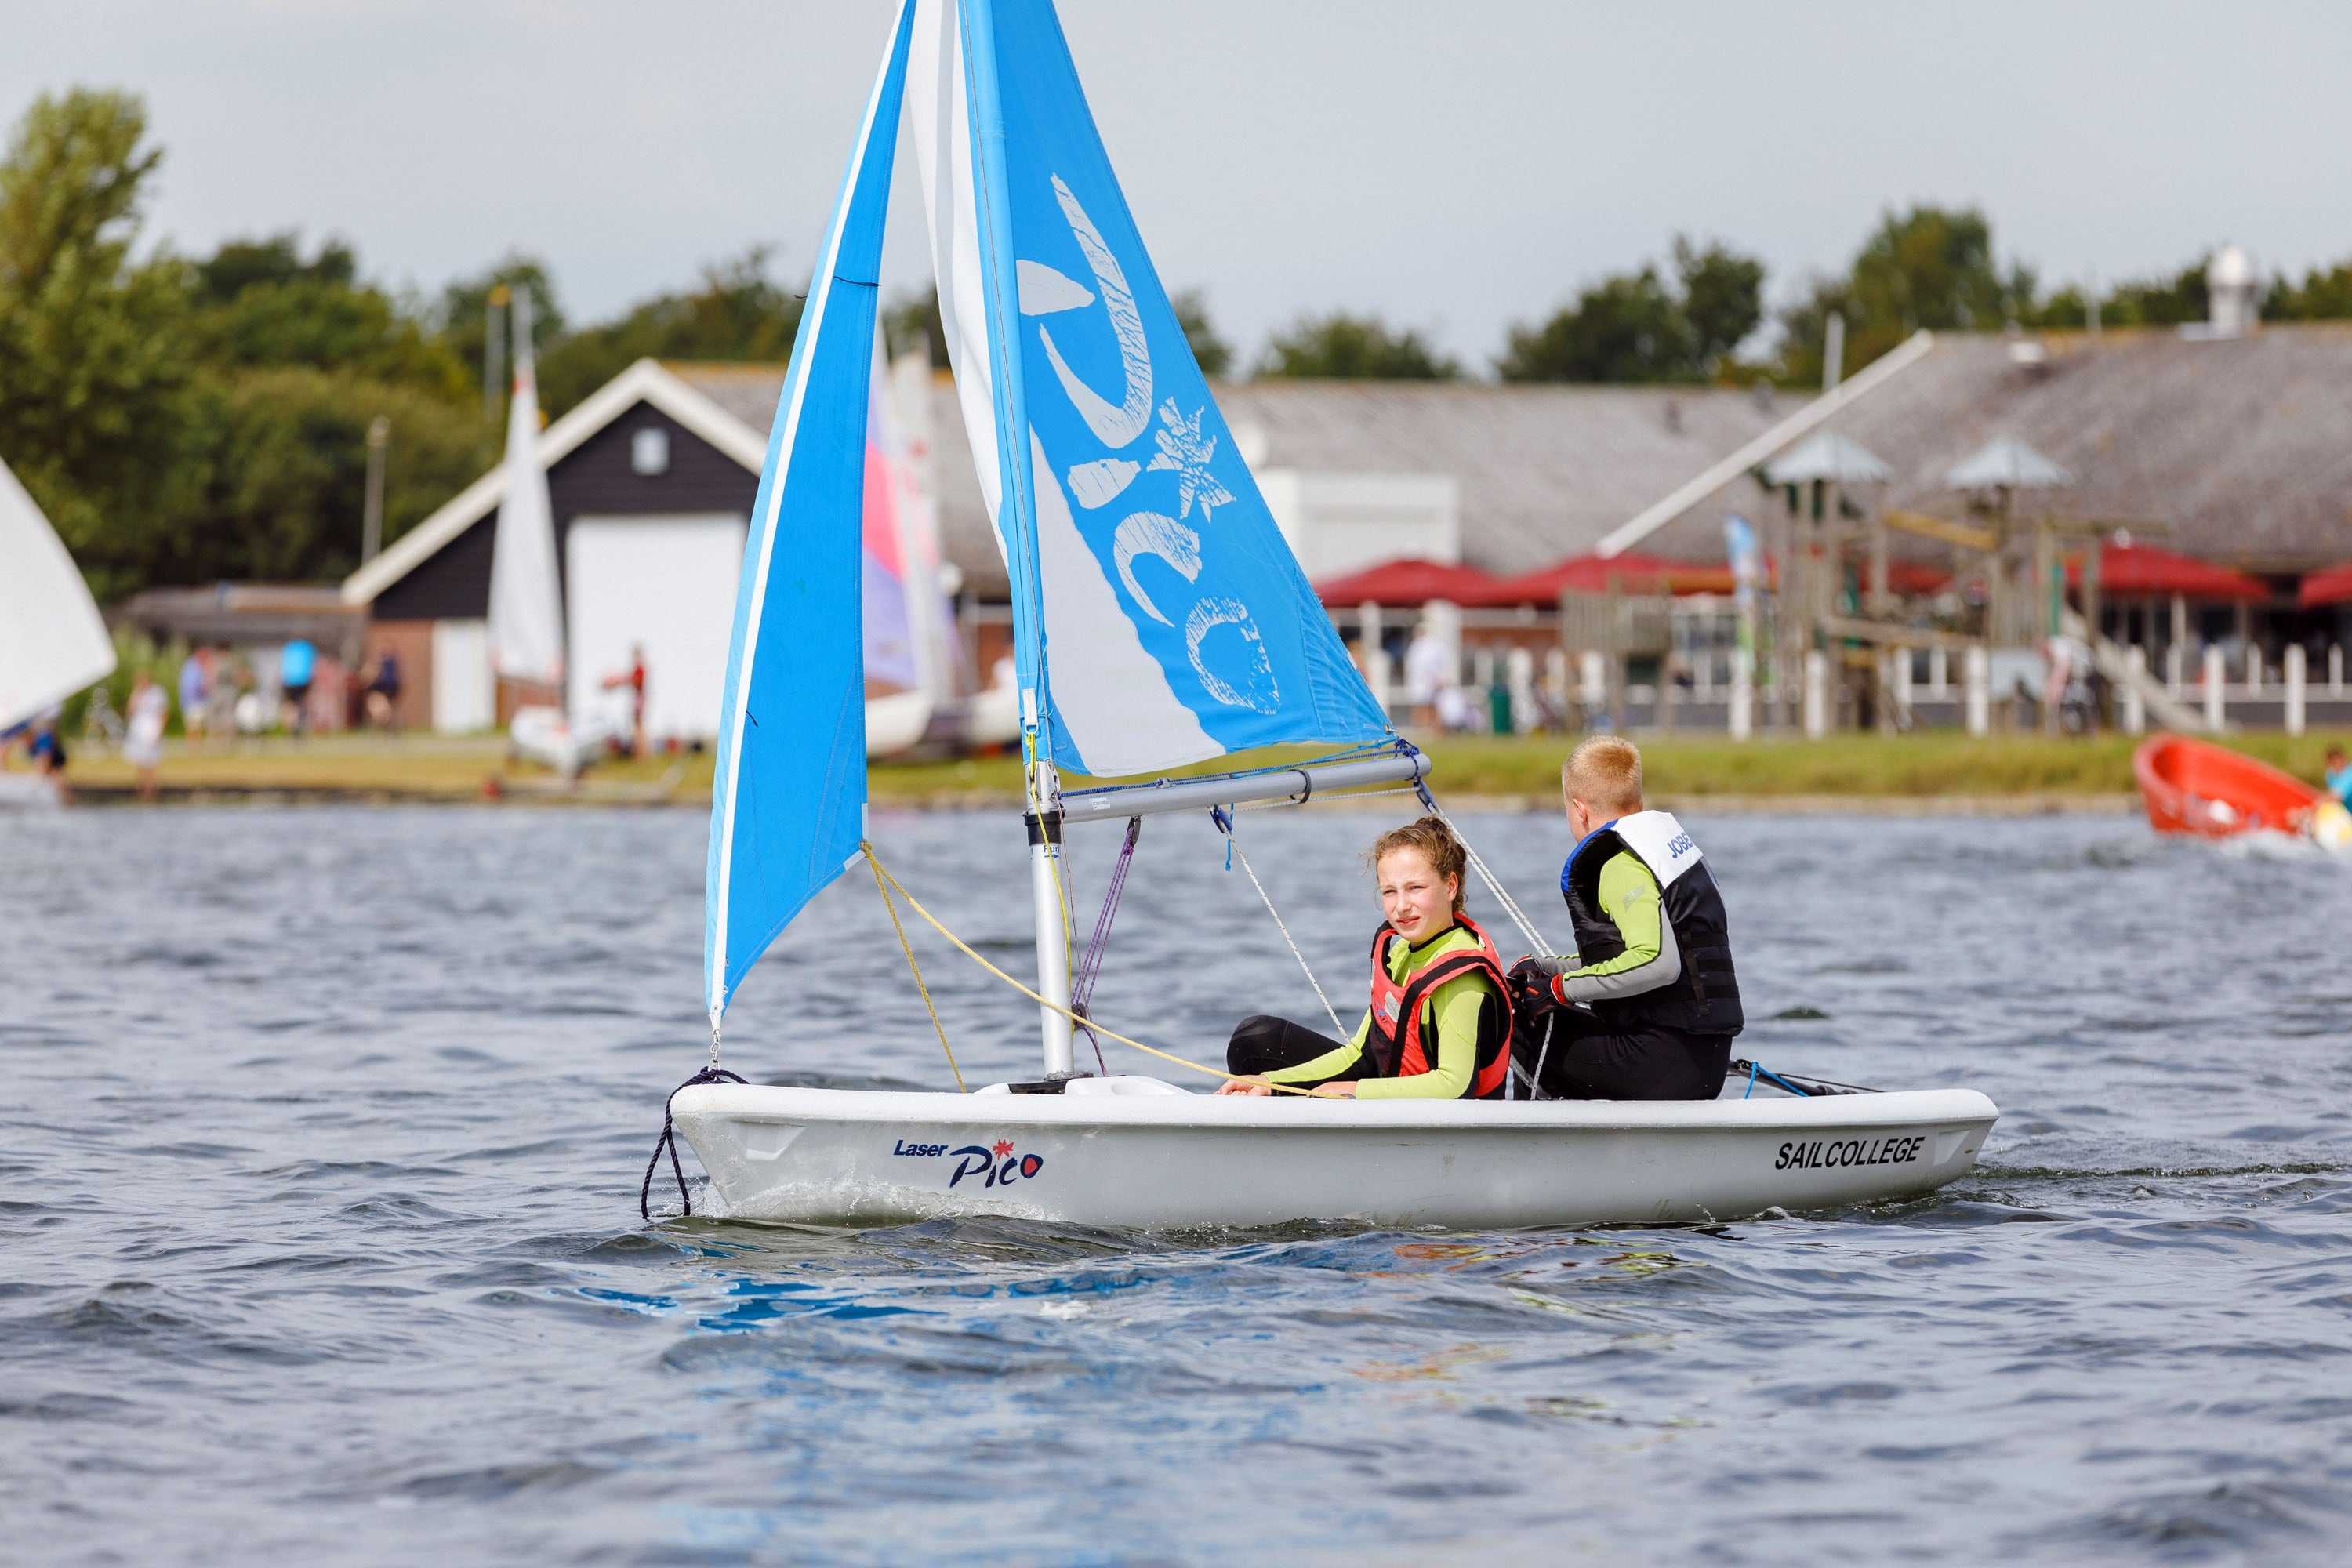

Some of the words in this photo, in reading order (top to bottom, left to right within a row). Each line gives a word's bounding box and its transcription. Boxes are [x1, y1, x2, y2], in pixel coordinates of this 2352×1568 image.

[1017, 172, 1281, 716] Pico
[893, 1139, 949, 1157] Laser
[949, 1138, 1044, 1189] Pico
[1775, 1136, 1926, 1170] SAILCOLLEGE
